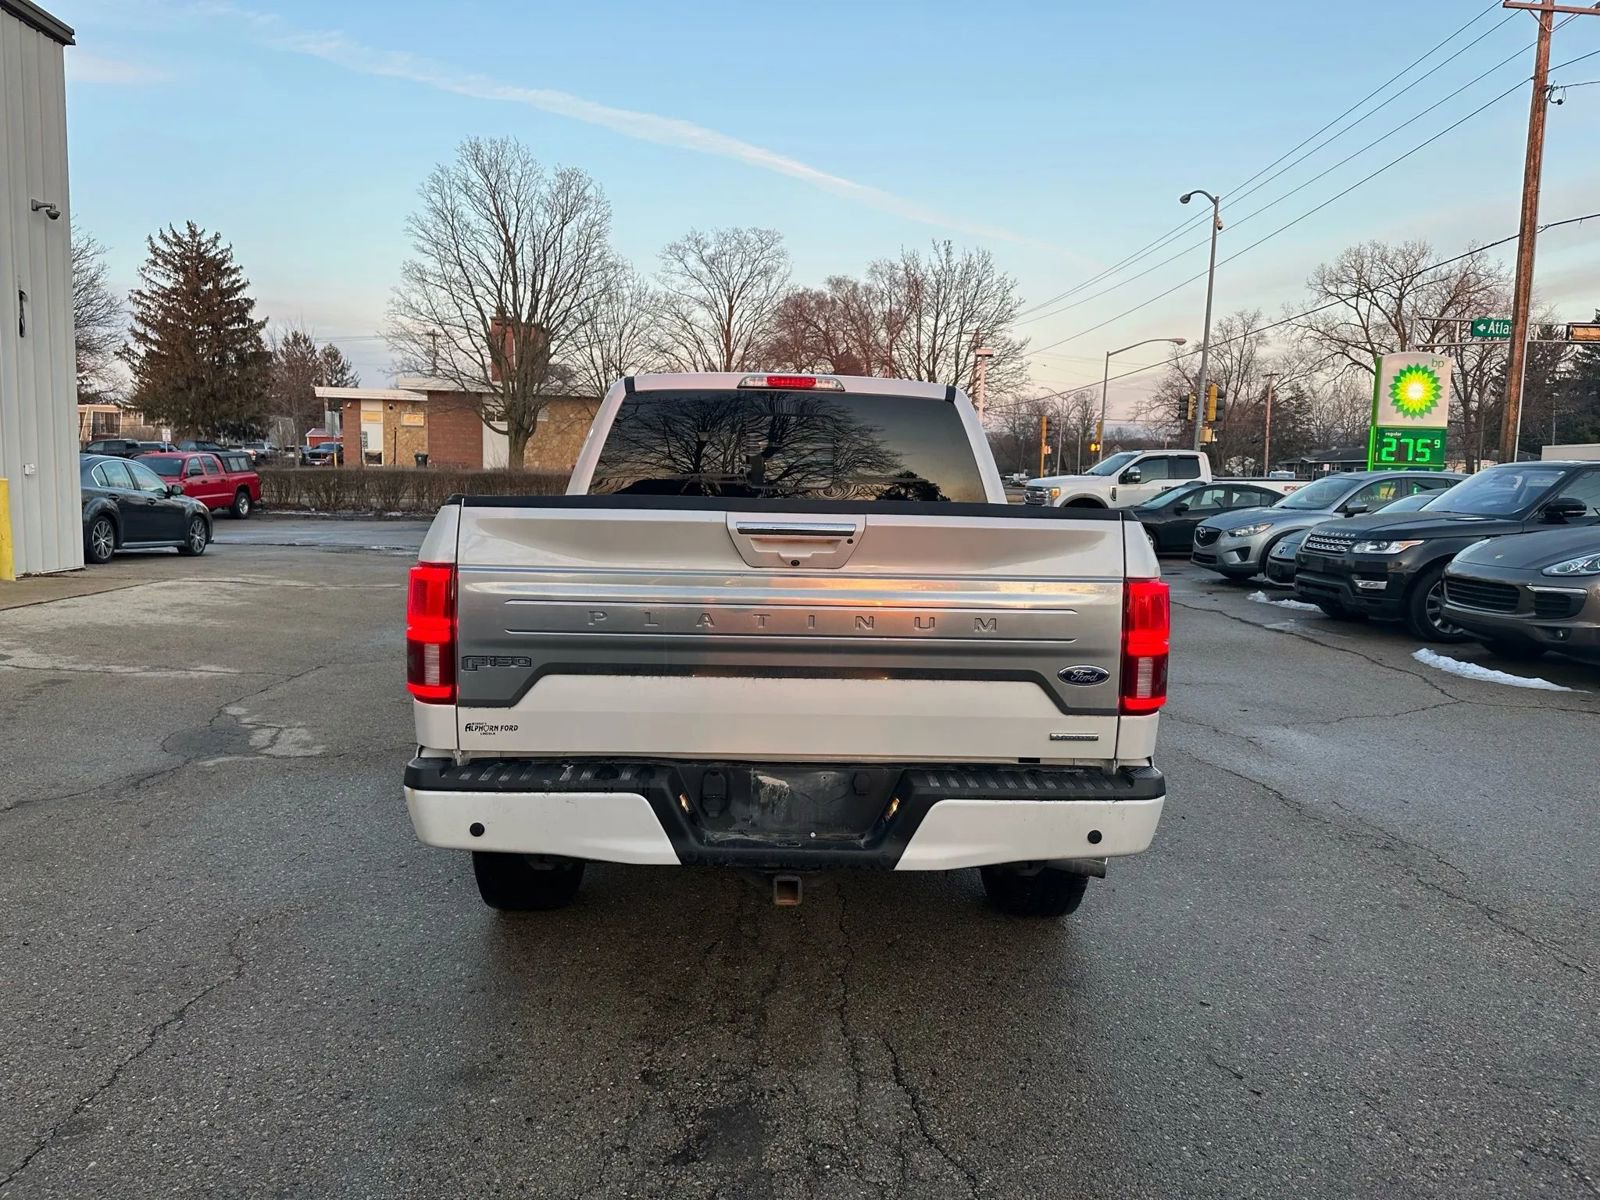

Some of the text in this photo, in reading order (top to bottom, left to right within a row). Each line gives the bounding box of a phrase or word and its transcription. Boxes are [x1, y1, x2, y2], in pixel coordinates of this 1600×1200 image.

[1431, 358, 1445, 369] bp
[1381, 438, 1441, 462] 275 9
[587, 610, 997, 633] PLATINUM
[1071, 669, 1098, 682] Ford
[465, 722, 499, 732] ALPHORN
[500, 724, 519, 732] FORD
